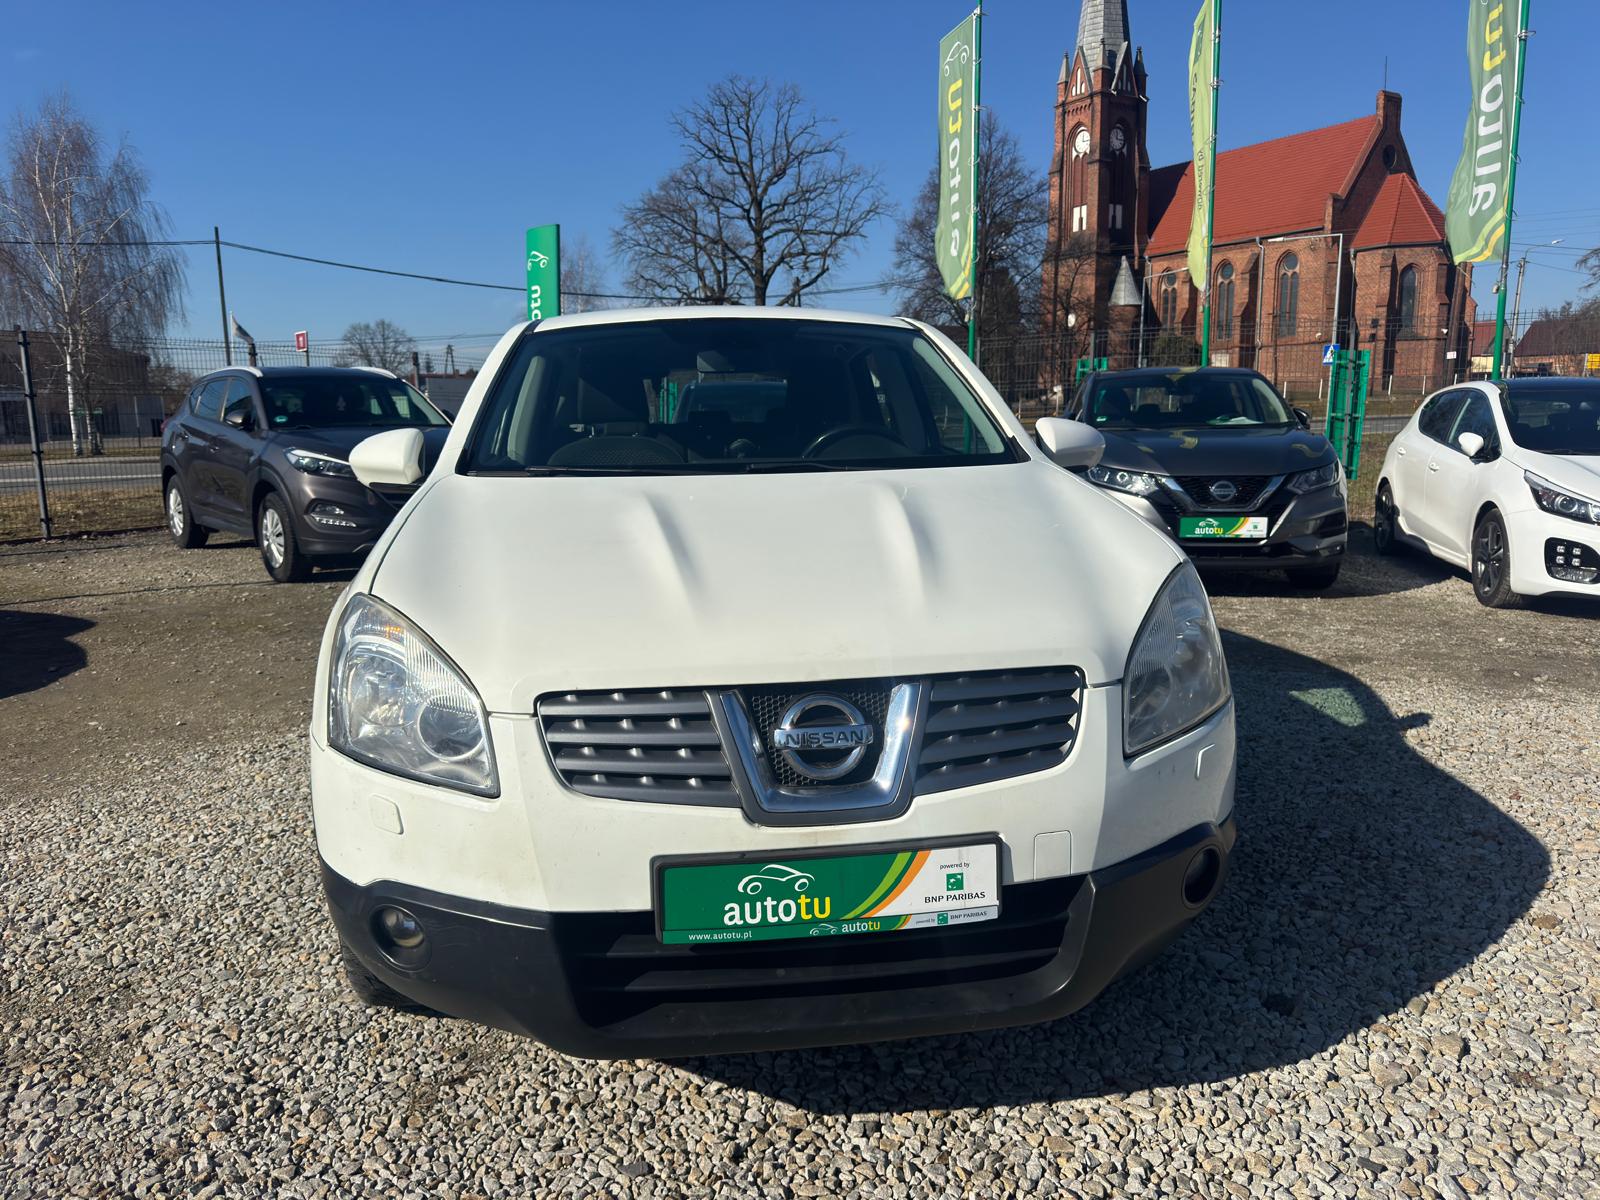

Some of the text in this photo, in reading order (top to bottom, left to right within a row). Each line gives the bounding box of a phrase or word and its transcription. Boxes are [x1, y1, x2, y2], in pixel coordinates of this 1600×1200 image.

[1195, 526, 1223, 535] autotu
[786, 729, 864, 746] NISSAN
[940, 862, 963, 870] powered
[924, 891, 986, 903] BNP PARIBAS
[723, 894, 831, 926] autotu
[842, 920, 881, 933] autotu
[688, 931, 752, 941] www.autotu.pl
